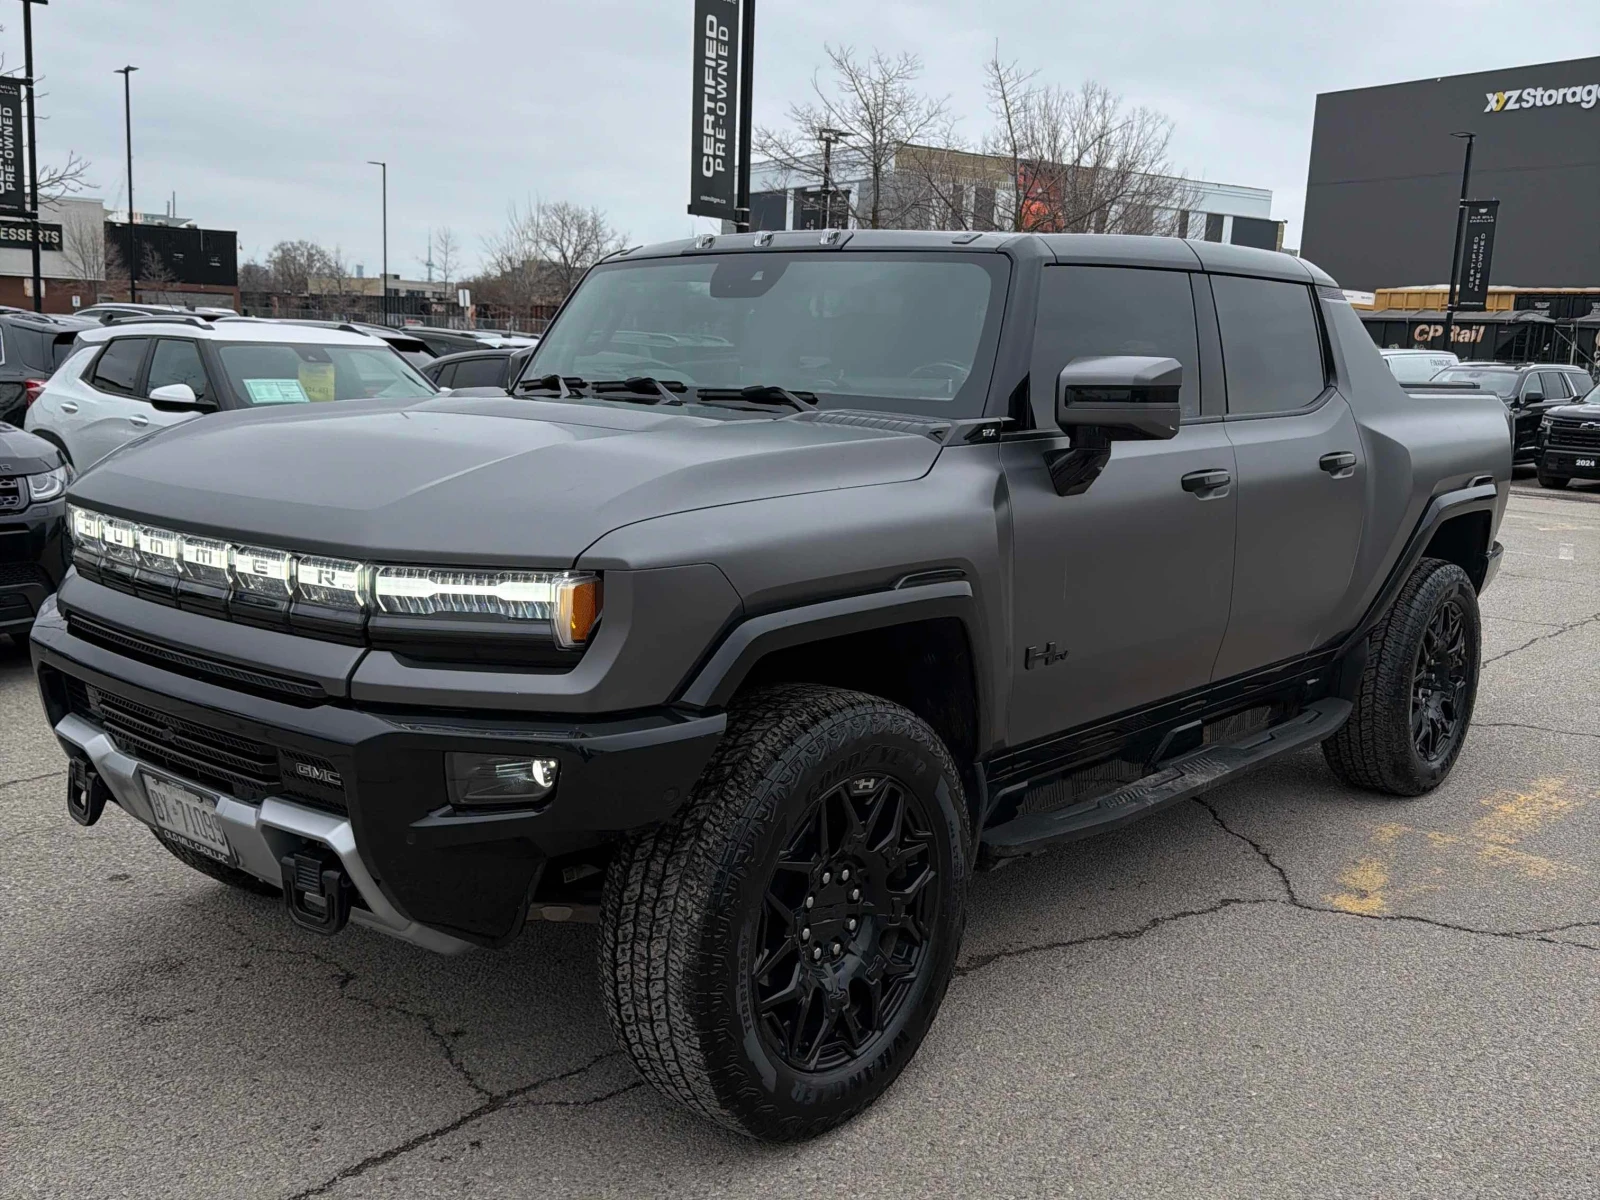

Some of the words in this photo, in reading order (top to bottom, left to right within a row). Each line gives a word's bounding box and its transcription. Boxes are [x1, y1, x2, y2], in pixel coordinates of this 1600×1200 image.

[702, 14, 718, 178] CERTIFIED
[715, 26, 729, 172] PRE-OWNED
[1521, 84, 1600, 109] Storag
[3, 107, 15, 191] PRE-OWNED
[1468, 236, 1479, 289] CERTIFIED
[1474, 233, 1486, 292] PRE-OWNED
[1414, 324, 1444, 342] CP
[1450, 325, 1486, 343] Rail
[1575, 459, 1595, 467] 2024
[84, 522, 335, 588] HUMMER
[296, 762, 341, 786] GMC
[178, 835, 195, 849] MILL
[194, 843, 229, 864] CADILLAC
